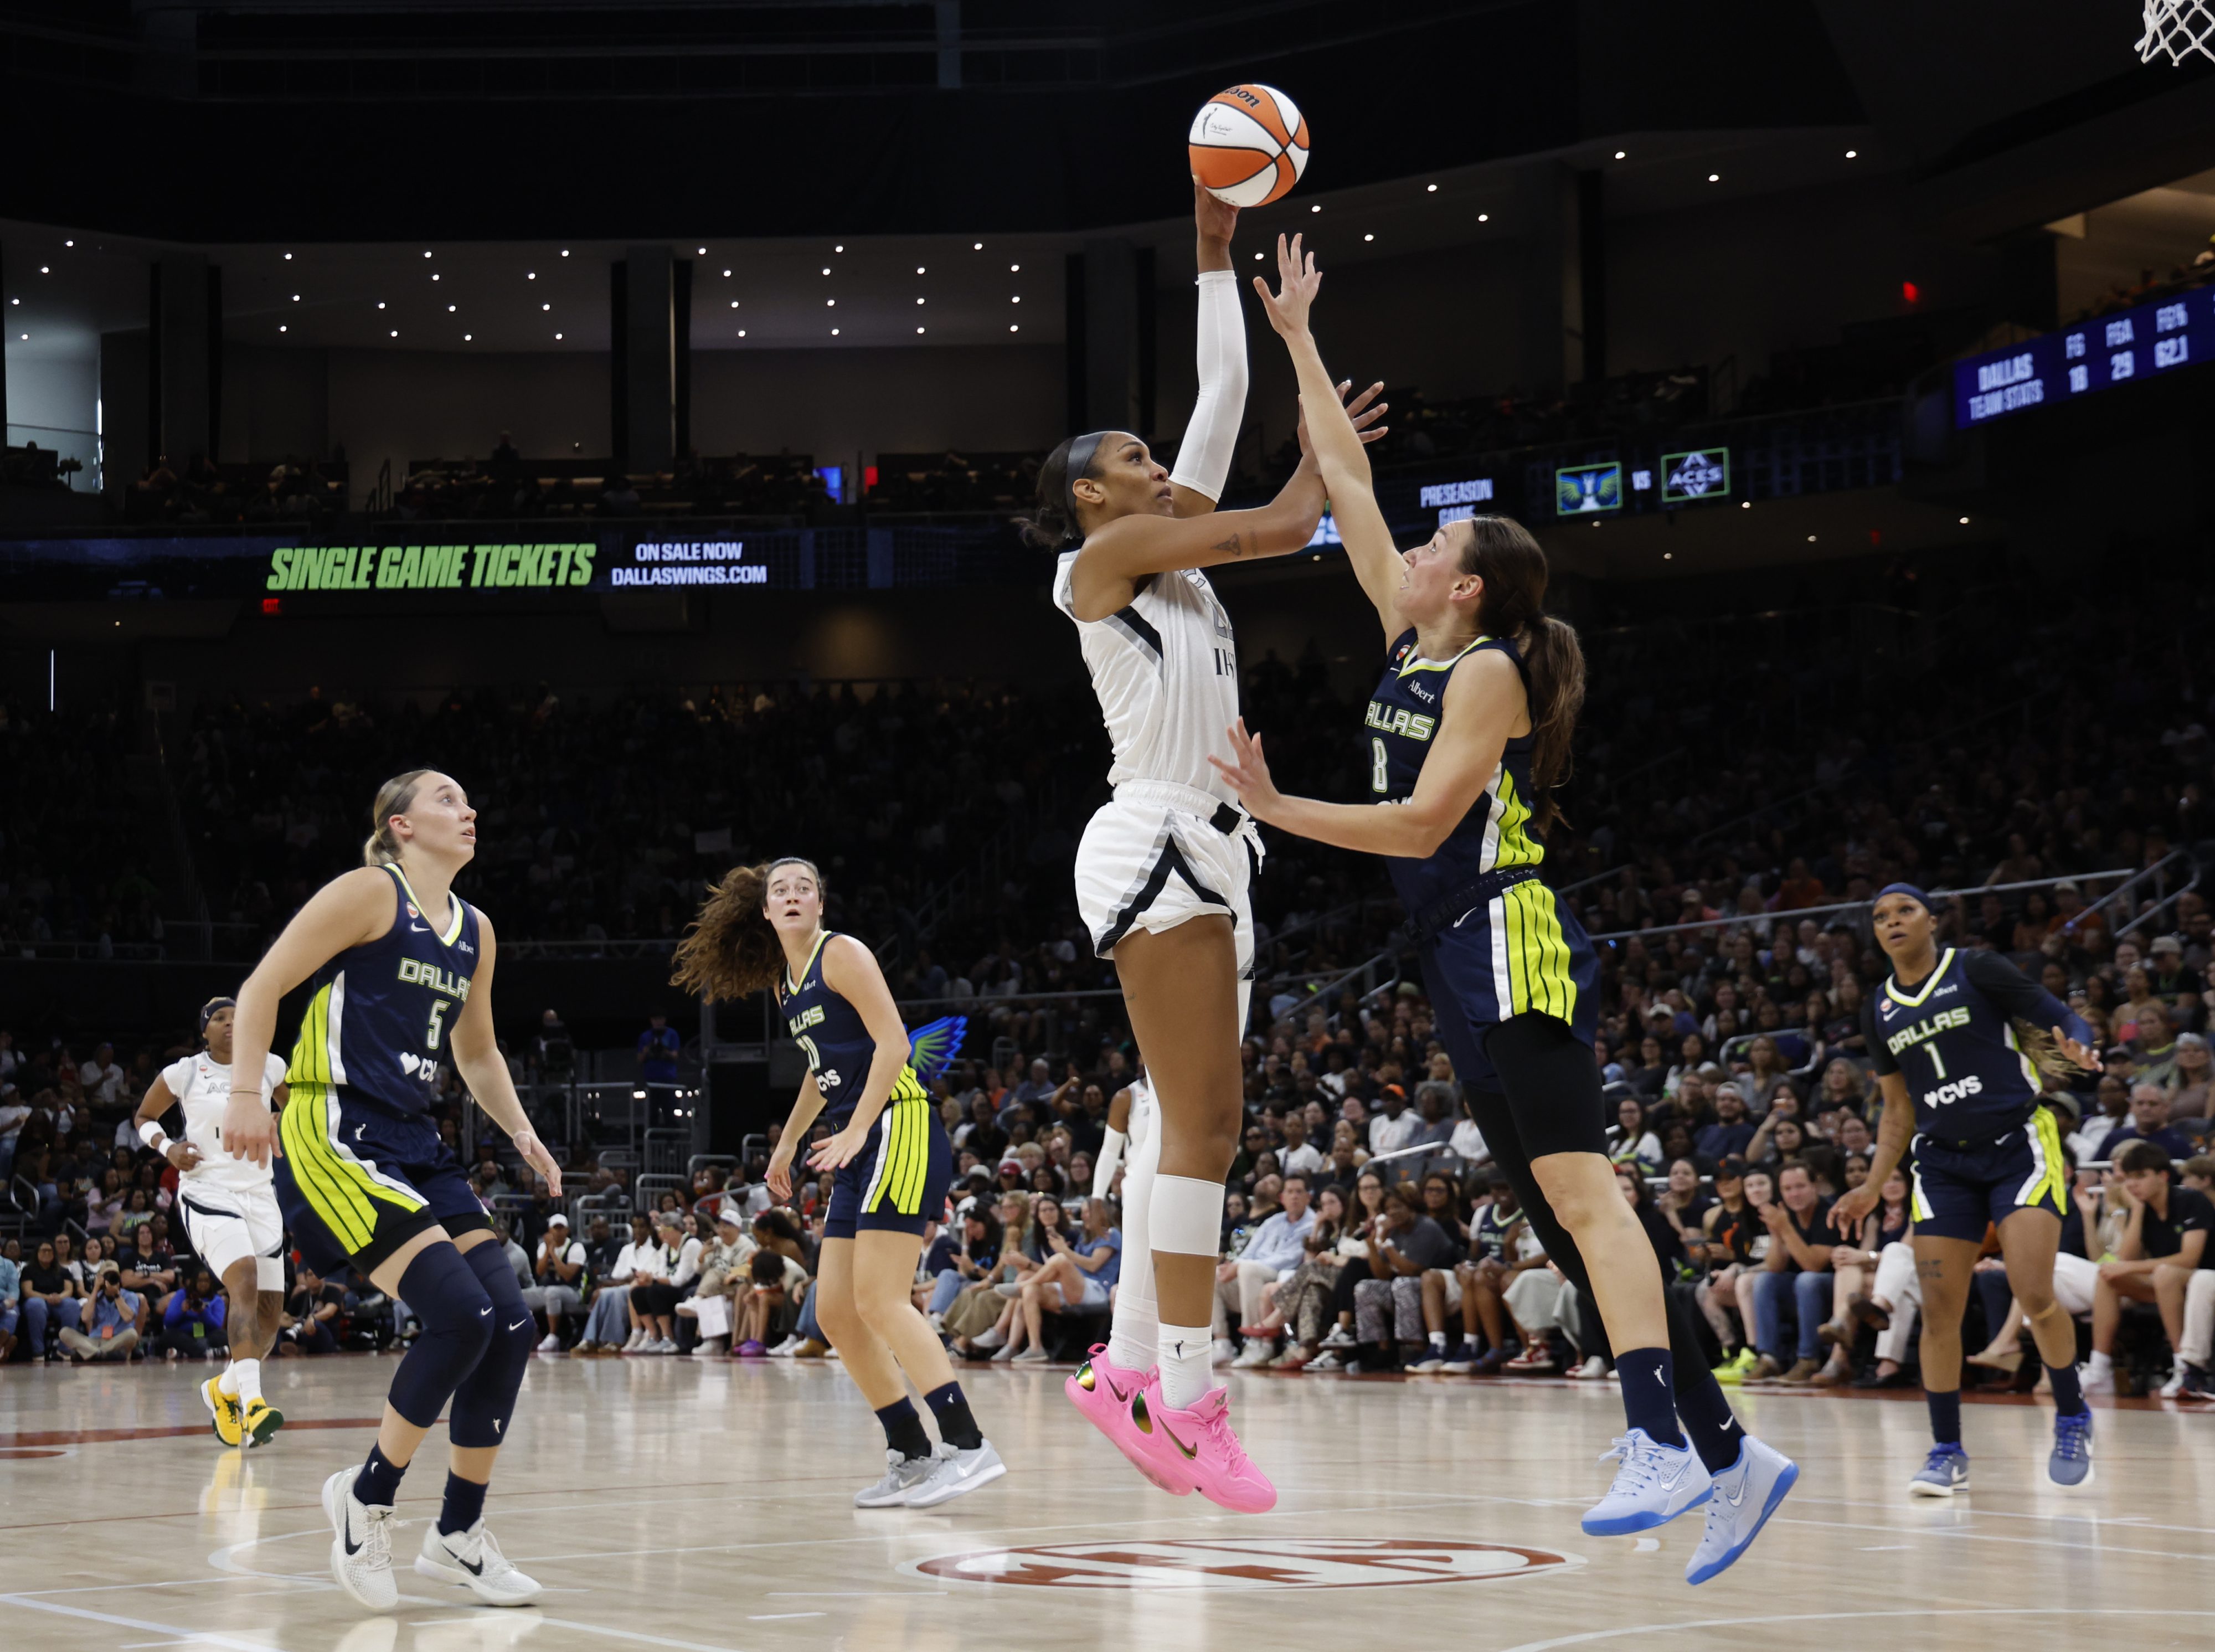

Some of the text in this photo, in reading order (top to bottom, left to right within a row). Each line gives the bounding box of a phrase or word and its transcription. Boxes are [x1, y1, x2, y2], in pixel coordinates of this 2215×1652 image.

[1221, 86, 1261, 109] son
[2065, 333, 2085, 359] FG
[1978, 353, 2033, 392] DALLAS
[2111, 351, 2134, 380] 29
[1969, 379, 2043, 420] TEAM STATS
[1632, 470, 1651, 491] VS
[1669, 466, 1722, 486] ACES
[1420, 478, 1493, 509] PRESEASON
[266, 543, 596, 590] SINGLE GAME TICKETS
[636, 542, 743, 562] ON SALE NOW
[611, 565, 767, 586] DALLASWINGS.COM
[1408, 680, 1435, 704] Albert
[1364, 701, 1435, 741] ALLAS
[1372, 737, 1388, 793] 8
[458, 940, 475, 955] Alber
[427, 999, 451, 1050] 5
[789, 1005, 826, 1037] ALLAS
[1887, 1006, 1971, 1056] DALLAS
[419, 1058, 437, 1082] CV
[1923, 1041, 1947, 1079] 1
[207, 1082, 230, 1095] AC
[816, 1069, 841, 1091] CVS
[1937, 1075, 1983, 1104] CVS
